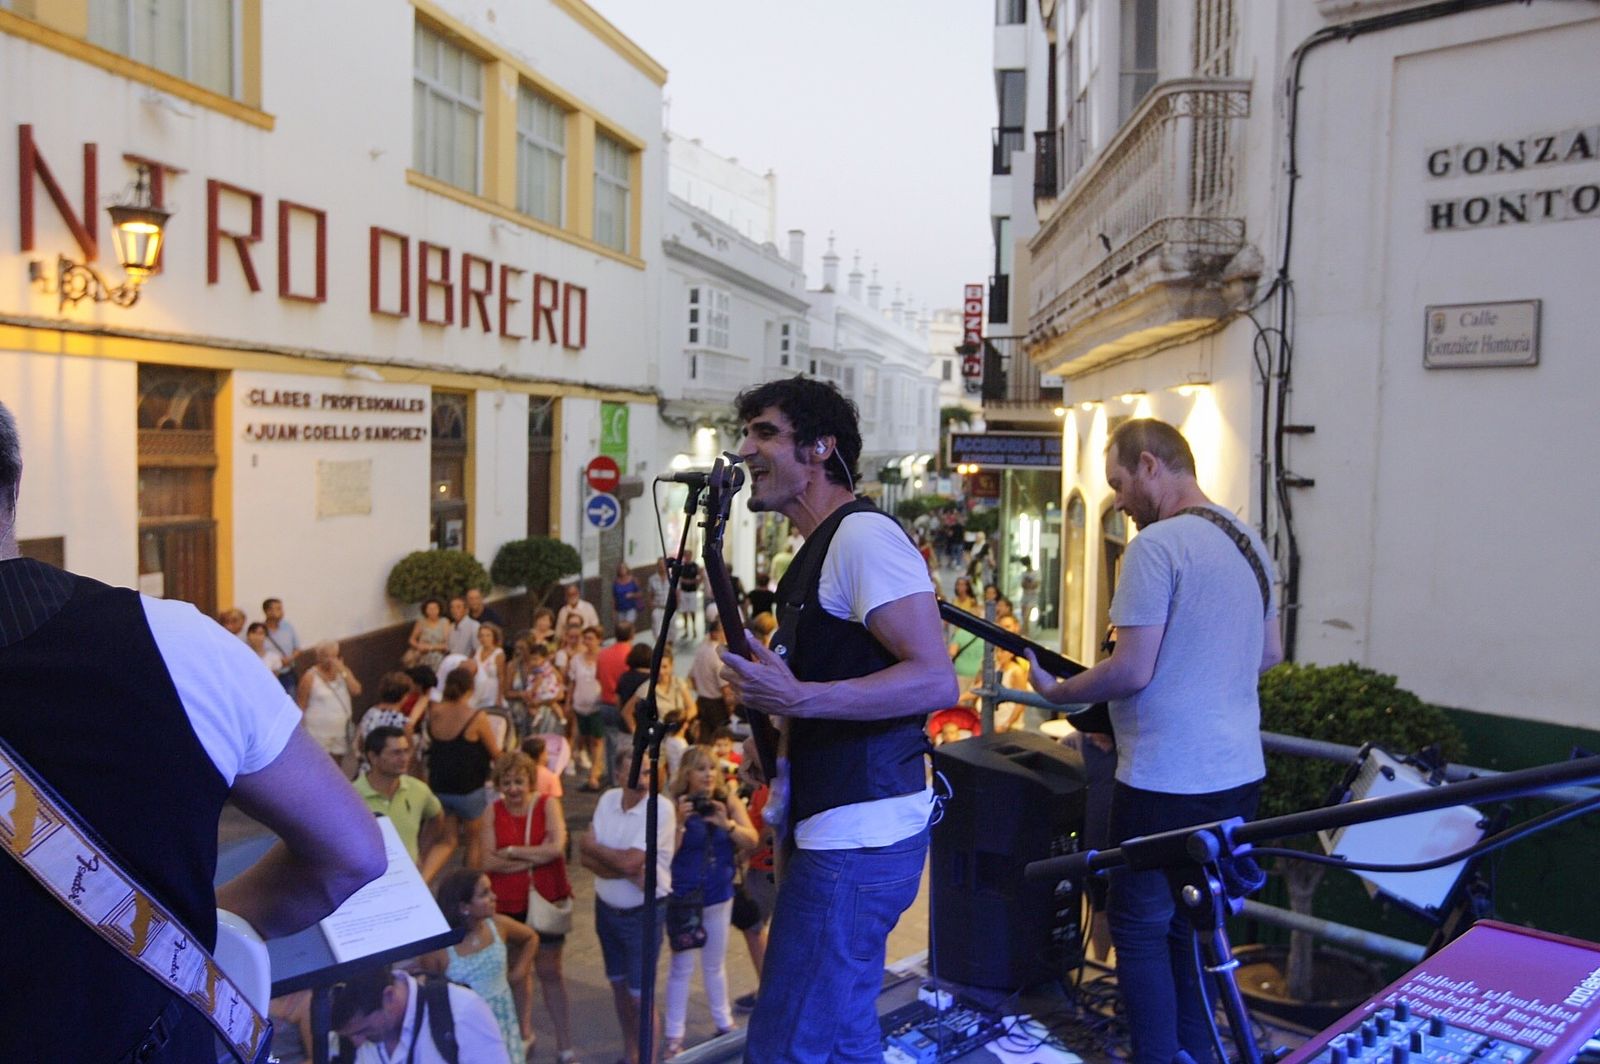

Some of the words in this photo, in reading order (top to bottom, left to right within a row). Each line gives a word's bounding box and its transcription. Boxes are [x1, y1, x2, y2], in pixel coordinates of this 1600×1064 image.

[1427, 131, 1594, 177] GONZA
[1430, 185, 1600, 230] HONTO
[370, 226, 588, 350] OBRERO
[1459, 310, 1499, 327] Calle
[249, 389, 312, 408] CLASES
[321, 394, 425, 412] PROFESIONALES
[303, 425, 361, 440] COELLO
